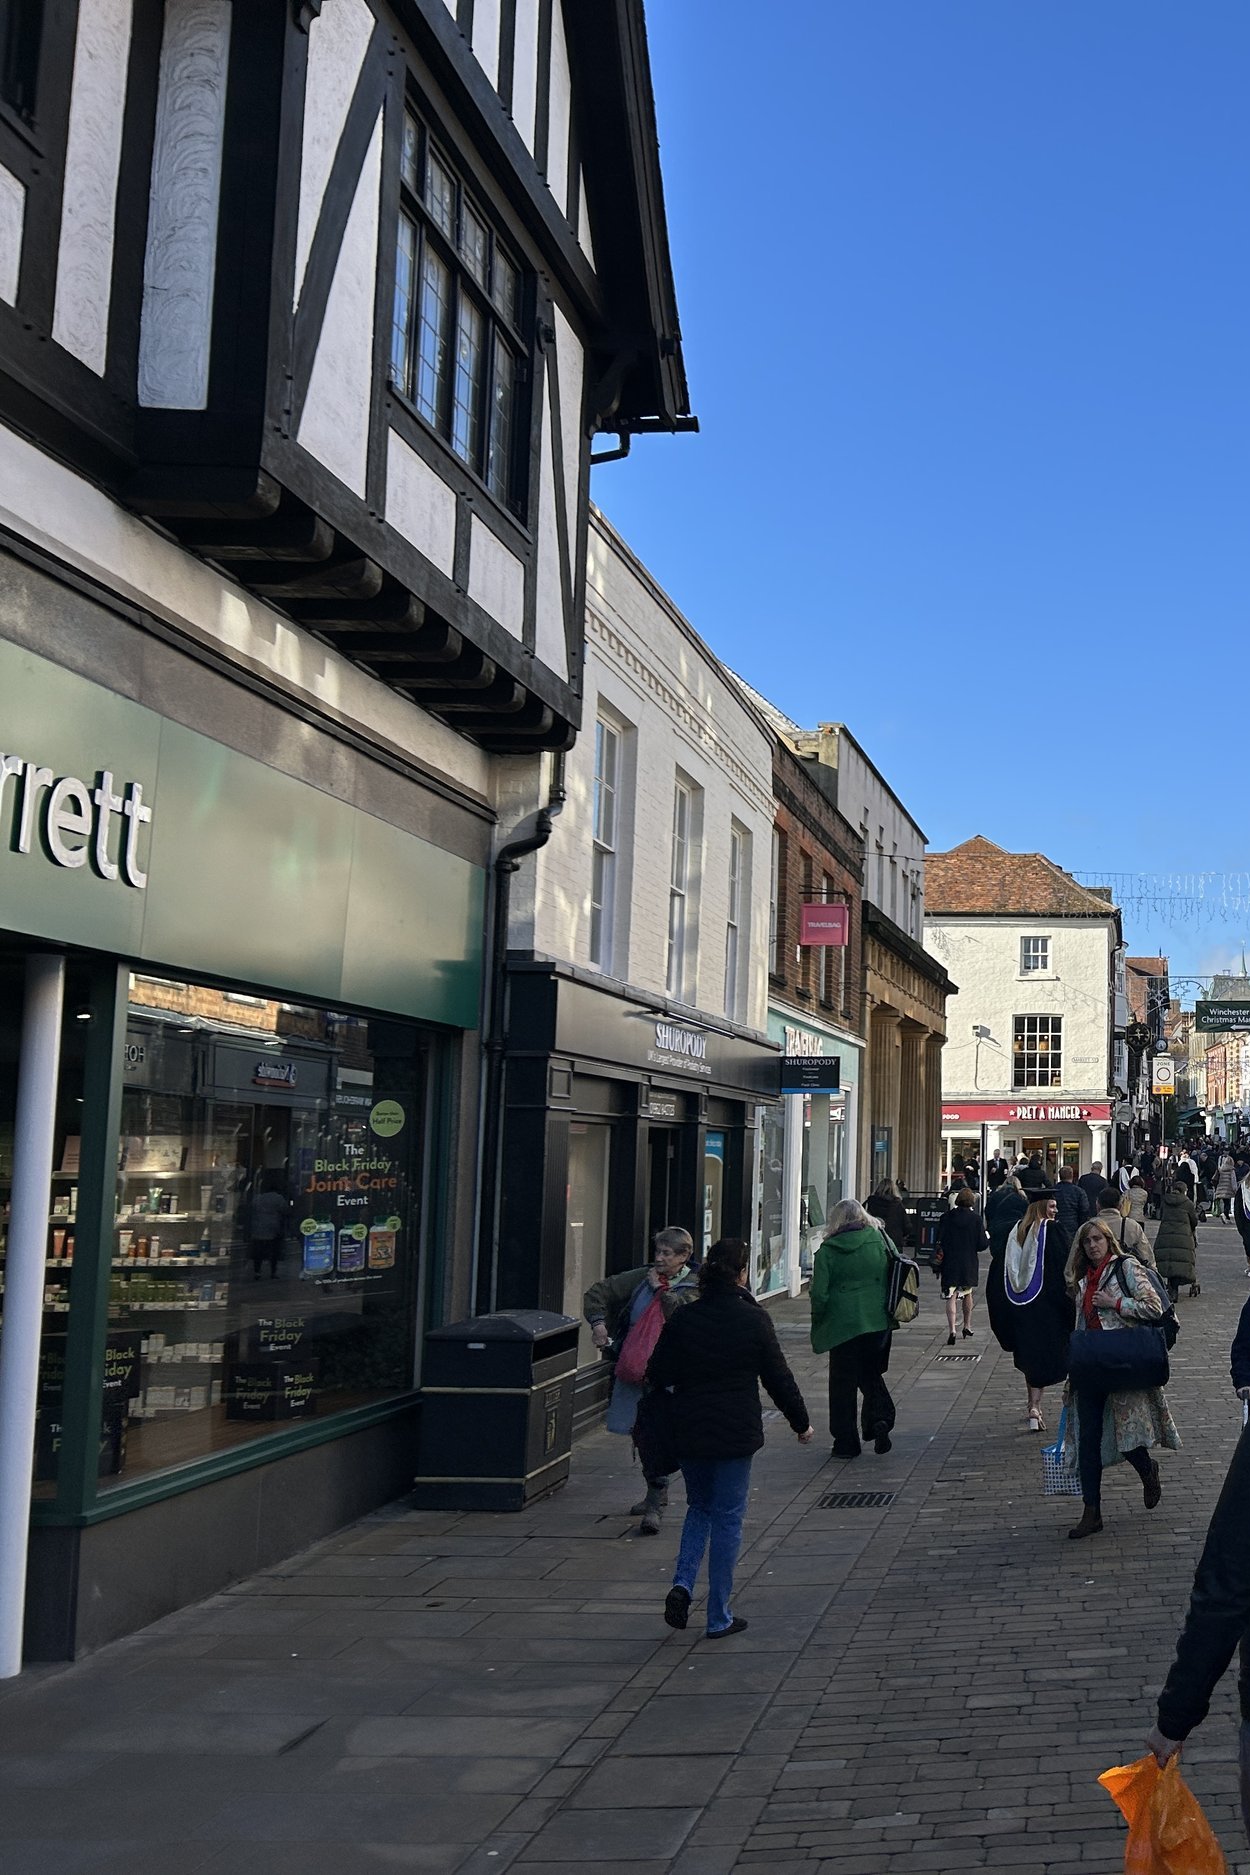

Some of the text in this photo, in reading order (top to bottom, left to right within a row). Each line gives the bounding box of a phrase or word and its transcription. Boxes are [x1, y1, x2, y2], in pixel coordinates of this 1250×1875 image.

[1209, 1008, 1249, 1016] Winchester
[1201, 1016, 1237, 1024] Christmas
[655, 1022, 707, 1059] SHUROPODY
[785, 1058, 837, 1066] SHUROPODY
[1016, 1105, 1081, 1120] PRET A MANGER
[343, 1143, 365, 1156] The
[314, 1158, 392, 1174] Black Friday
[305, 1172, 397, 1194] Joint Care
[336, 1194, 369, 1207] Event
[258, 1317, 305, 1329] The Black
[260, 1330, 303, 1344] Friday
[105, 1347, 136, 1361] Black
[269, 1343, 292, 1352] Event
[104, 1362, 133, 1380] iday
[294, 1373, 314, 1384] Black
[236, 1388, 270, 1404] Friday
[284, 1386, 312, 1399] Friday
